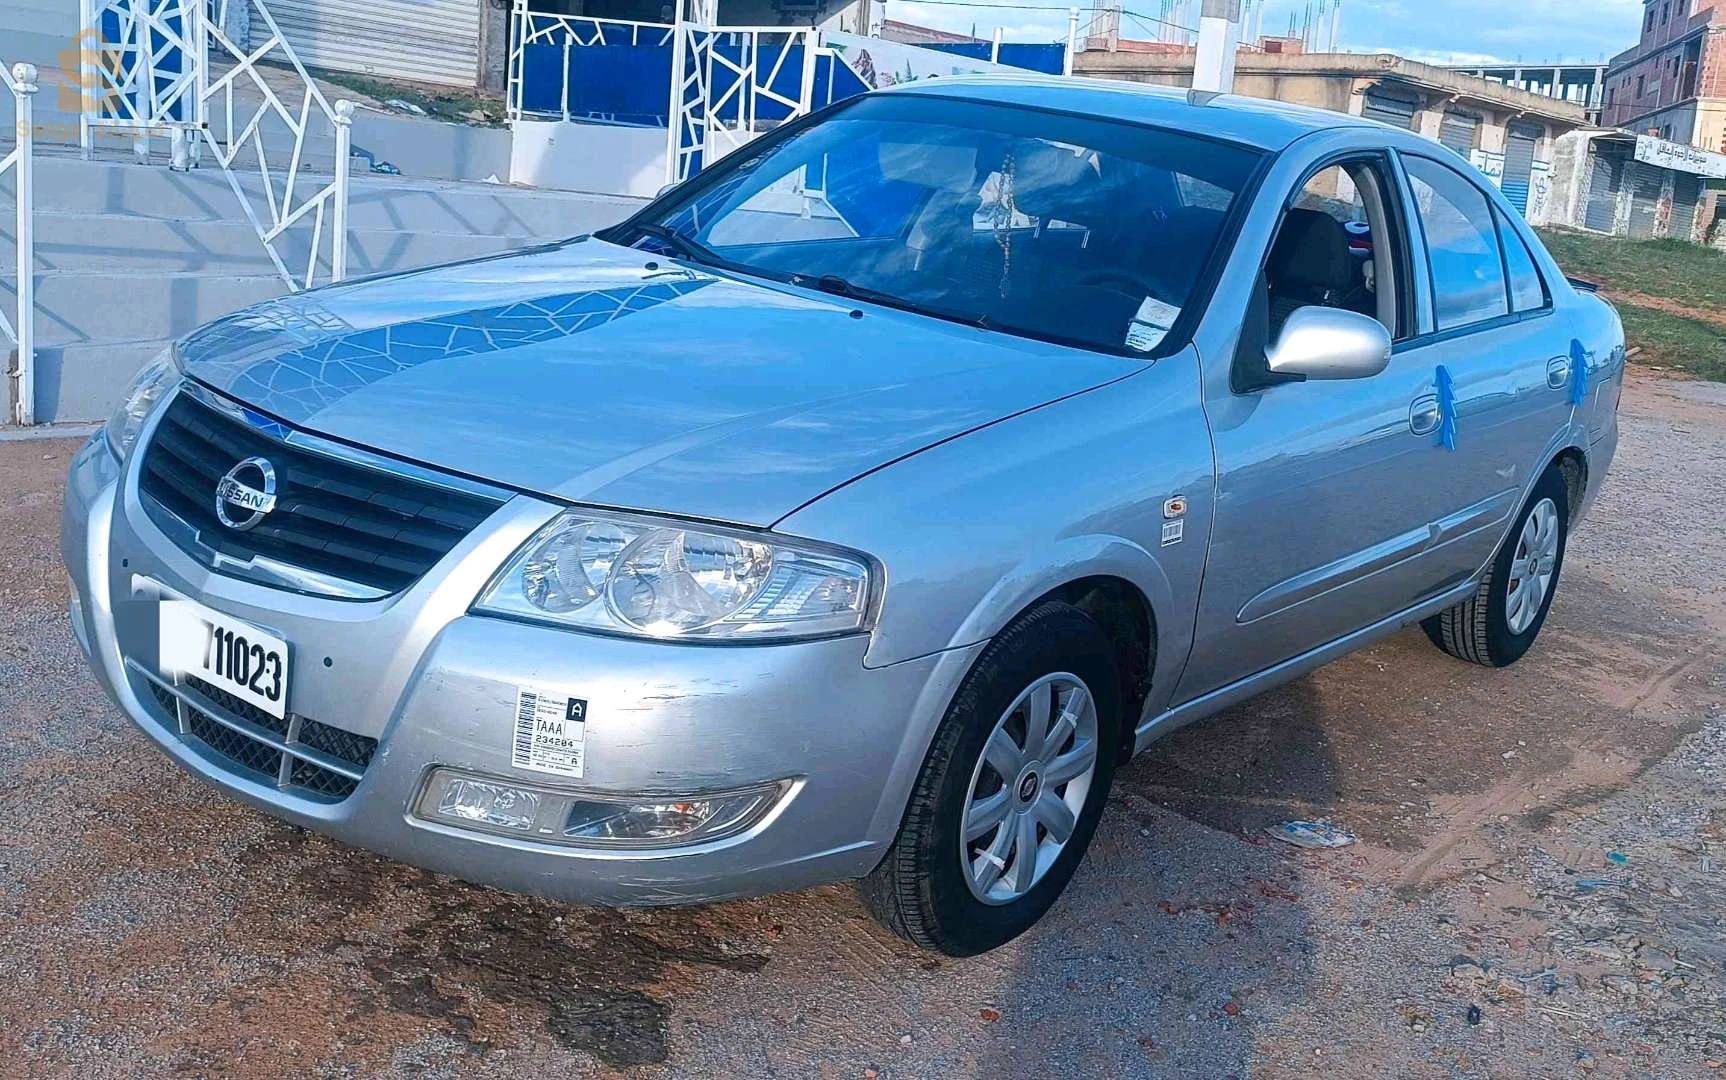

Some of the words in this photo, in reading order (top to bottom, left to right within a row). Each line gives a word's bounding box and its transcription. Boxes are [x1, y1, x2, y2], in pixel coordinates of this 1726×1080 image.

[218, 478, 265, 508] NISSAN
[572, 702, 583, 717] A
[536, 718, 562, 736] TAAA
